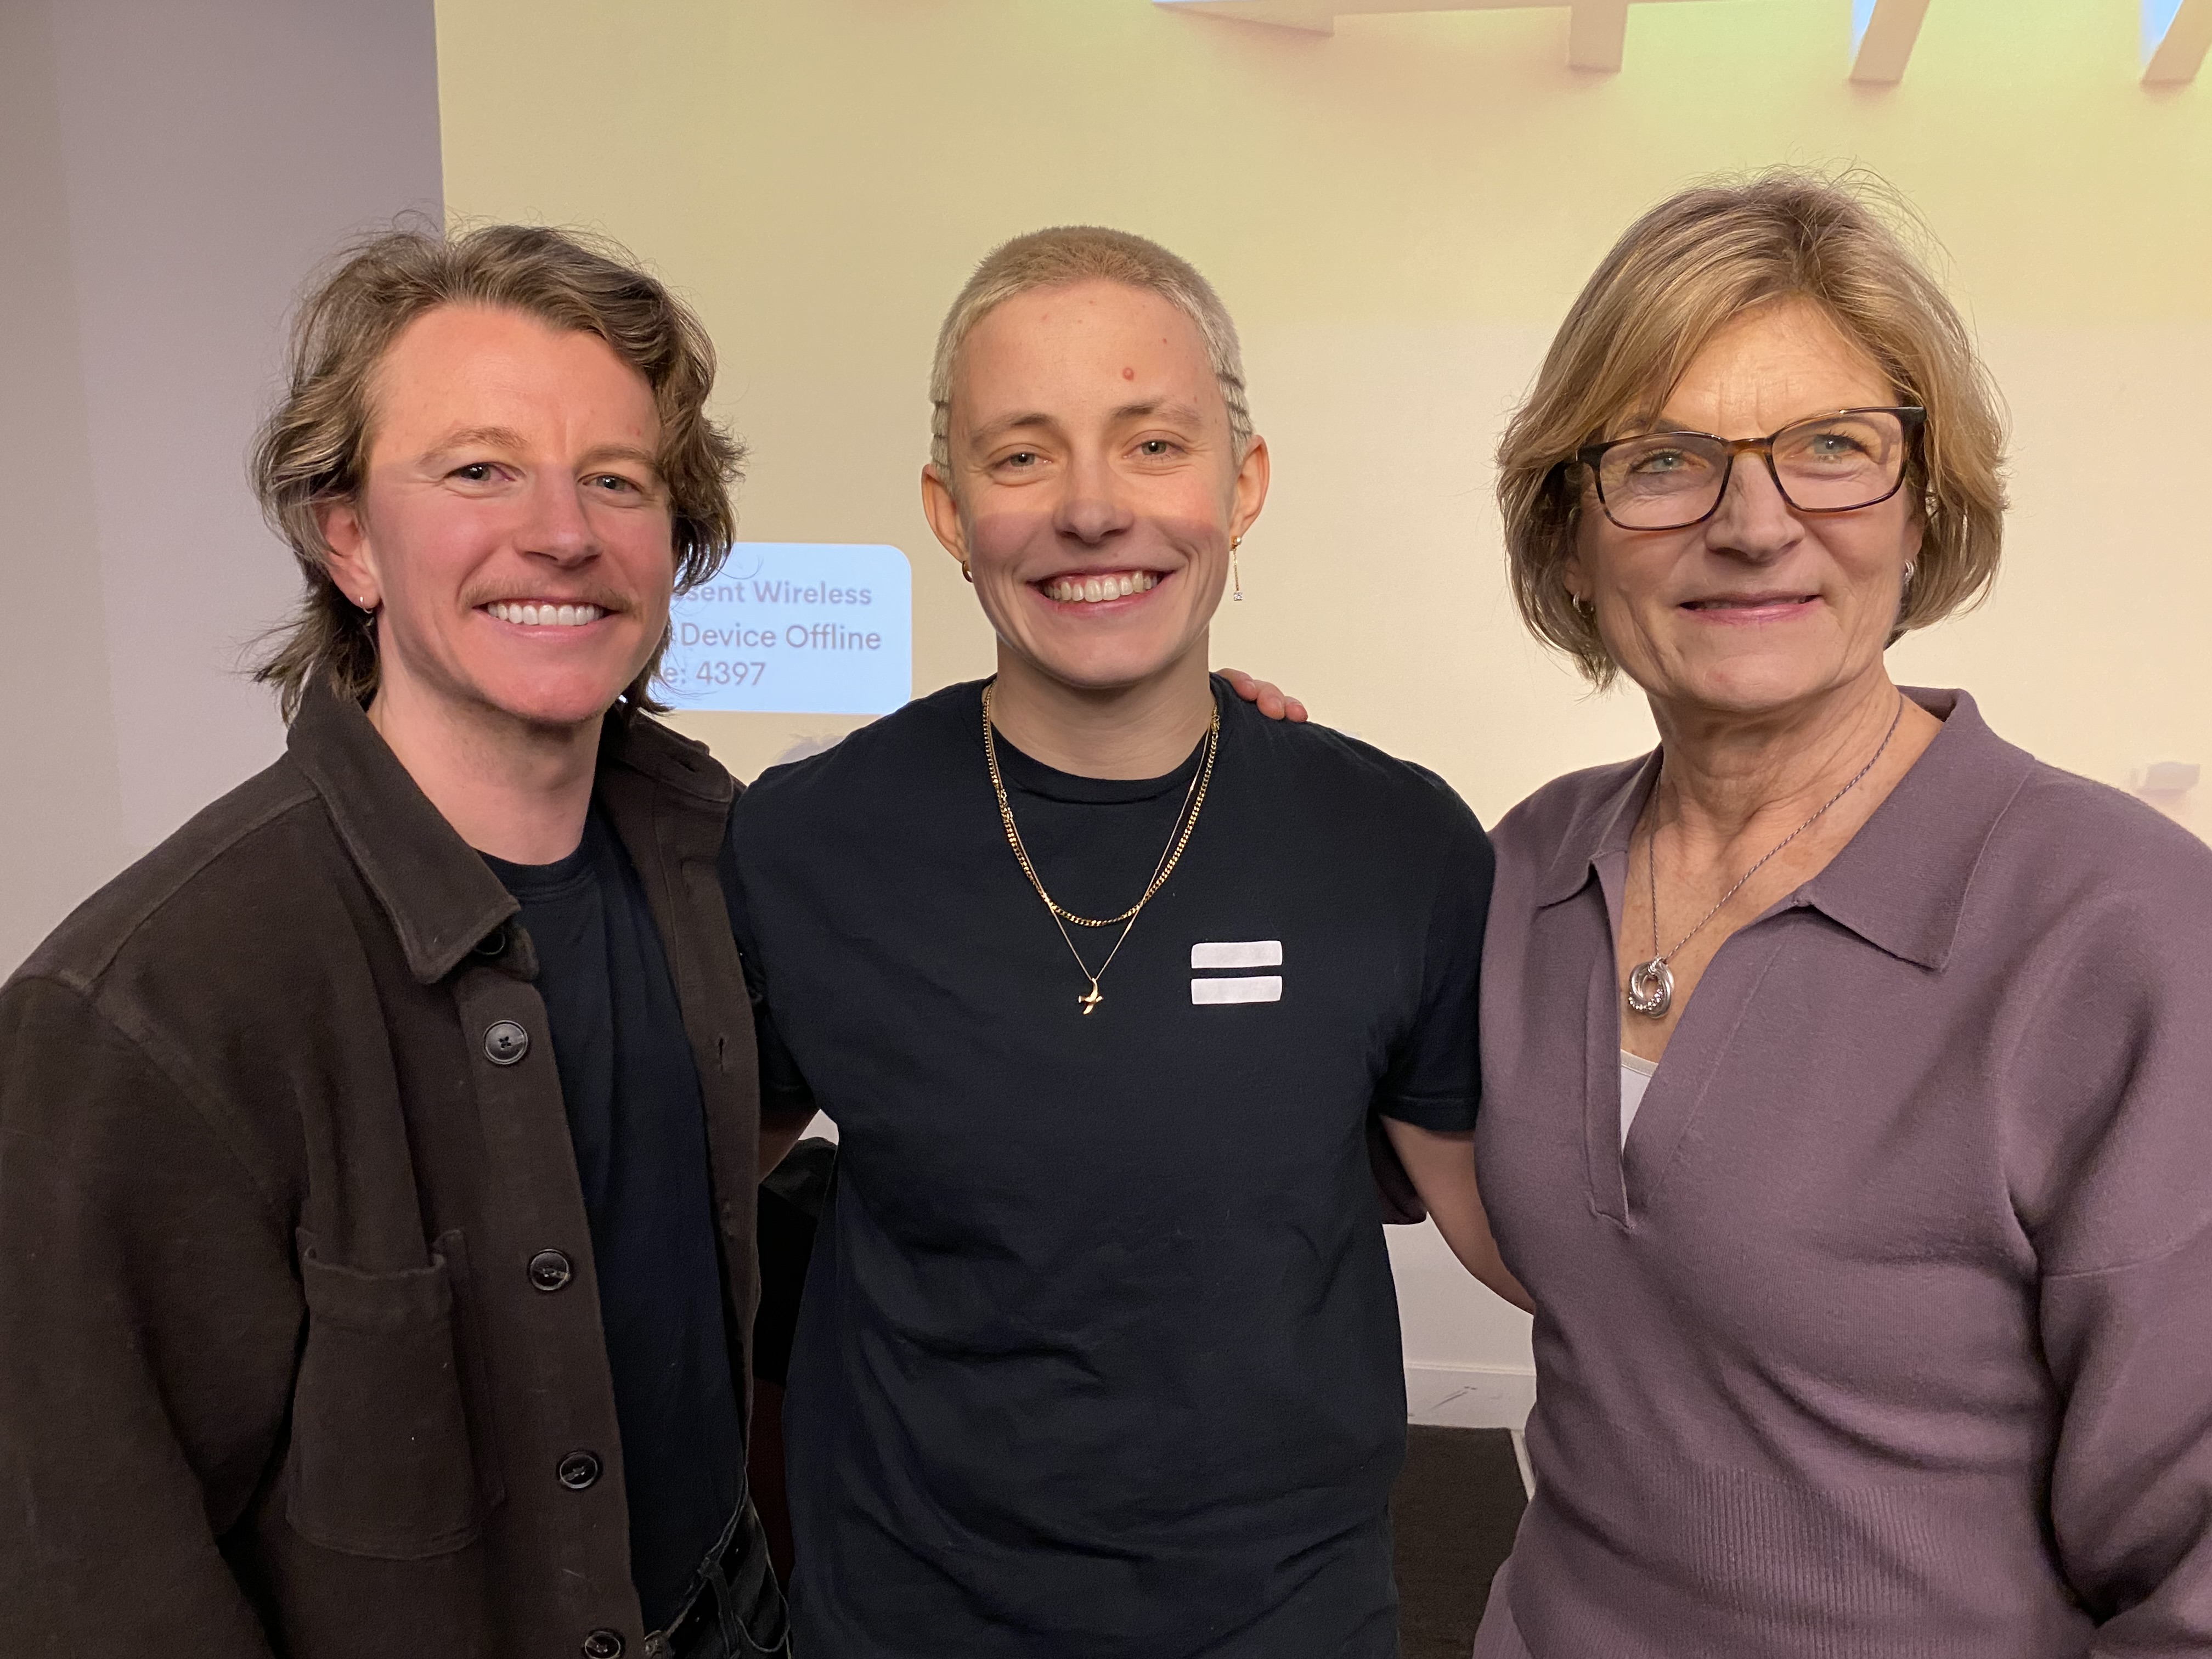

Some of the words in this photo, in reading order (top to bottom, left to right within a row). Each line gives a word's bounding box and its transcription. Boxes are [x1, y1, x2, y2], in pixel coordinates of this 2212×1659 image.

[670, 581, 745, 602] sent
[753, 580, 872, 605] Wireless
[681, 622, 776, 647] Device
[786, 623, 882, 650] Offline
[696, 661, 766, 686] 4397
